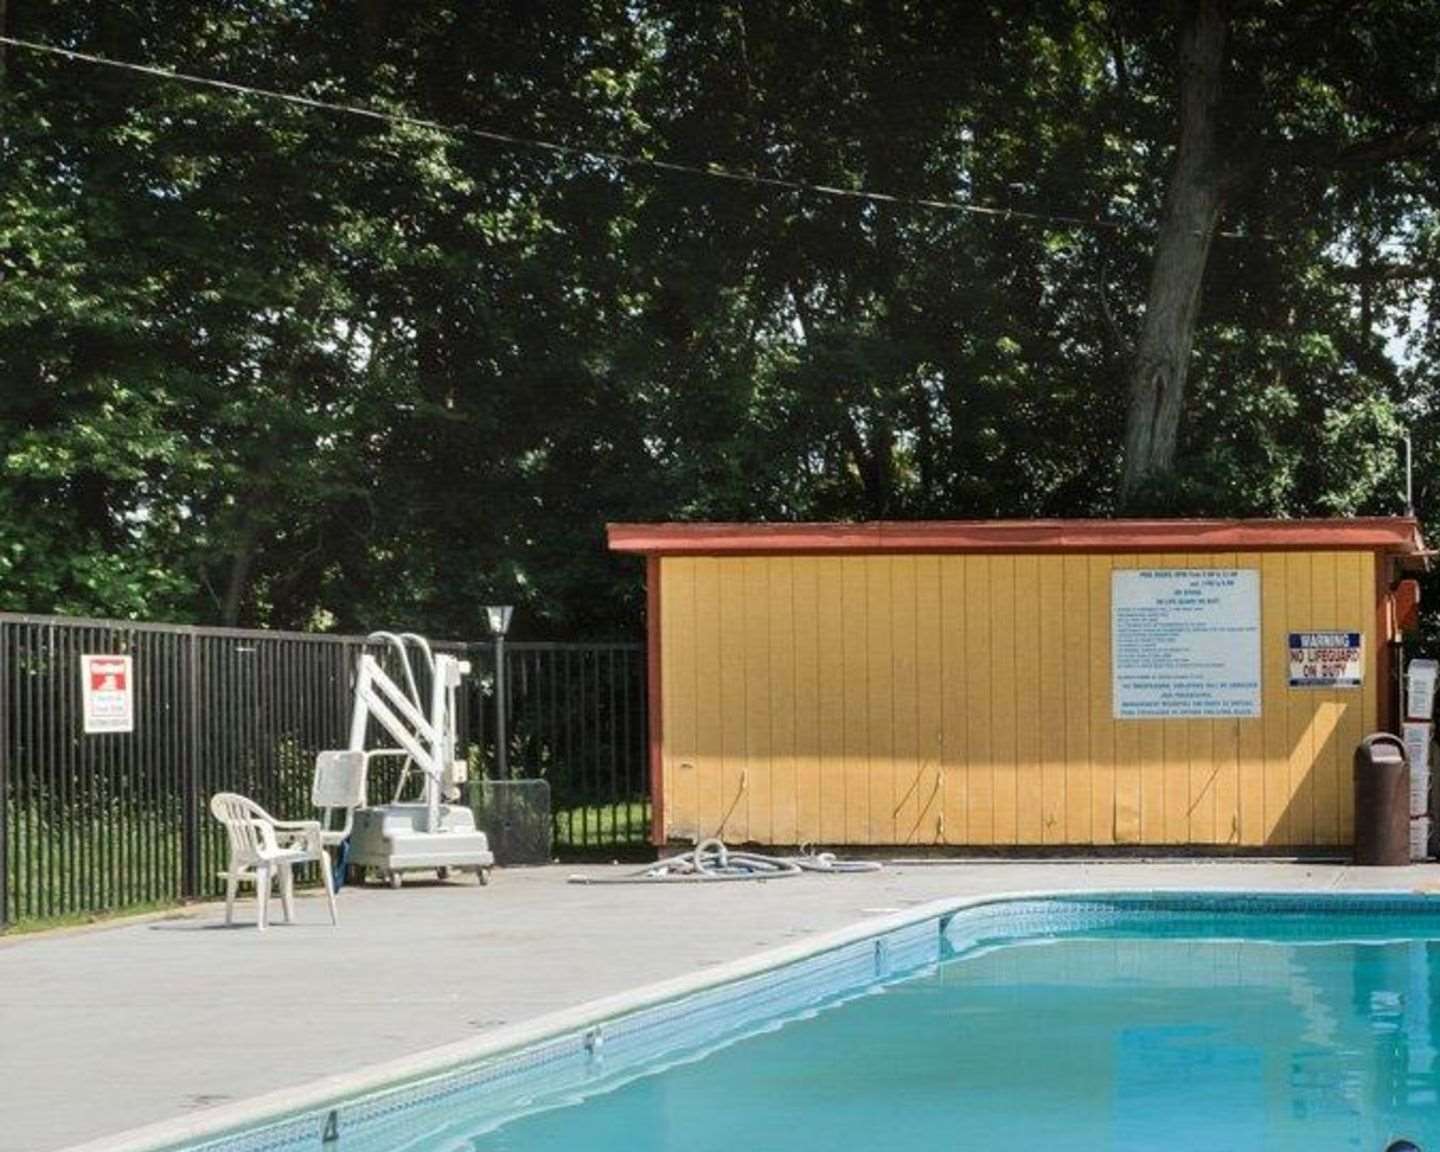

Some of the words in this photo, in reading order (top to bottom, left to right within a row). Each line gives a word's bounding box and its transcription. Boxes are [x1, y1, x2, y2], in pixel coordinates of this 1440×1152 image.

[1301, 635, 1350, 648] WARNING
[1290, 649, 1304, 663] NO
[1307, 649, 1360, 662] LIFEGUARD
[1303, 664, 1317, 677] ON
[1321, 664, 1346, 677] DUTY
